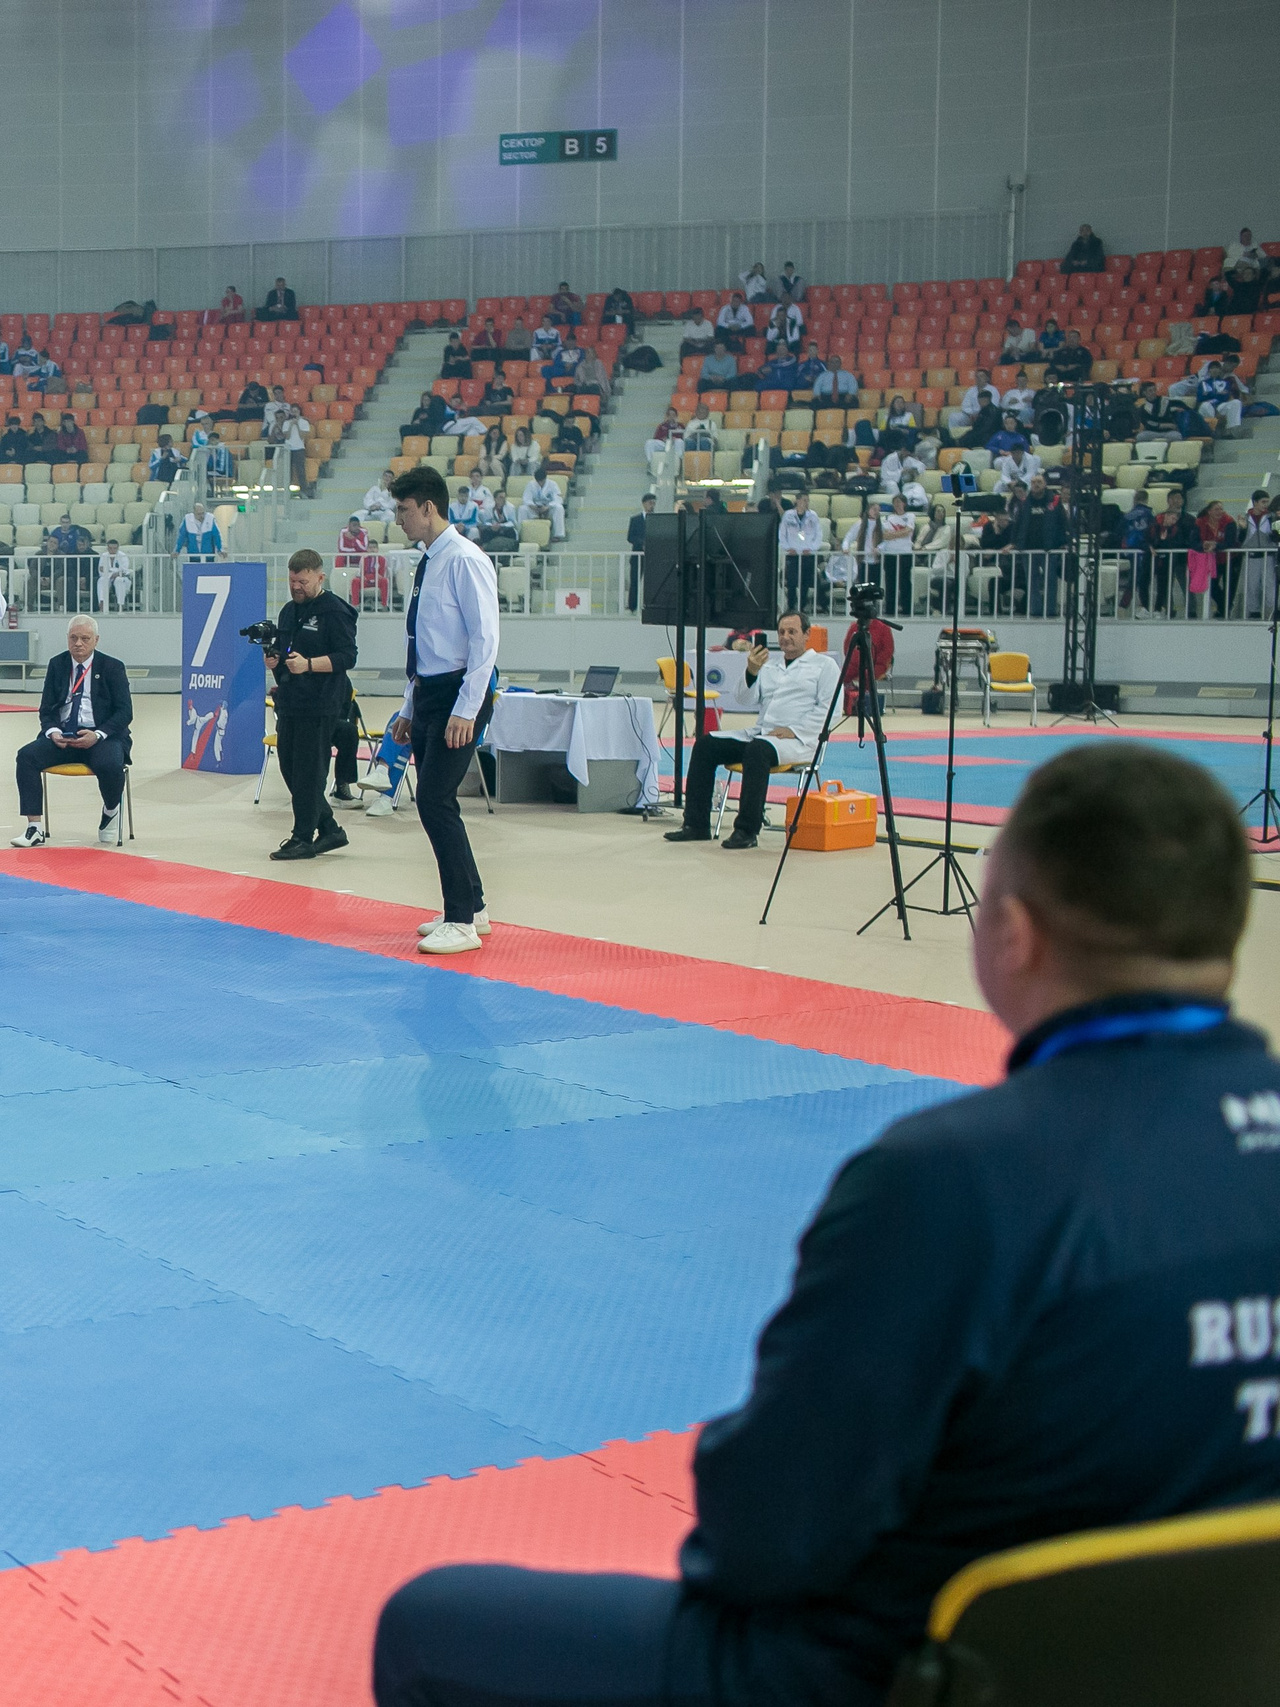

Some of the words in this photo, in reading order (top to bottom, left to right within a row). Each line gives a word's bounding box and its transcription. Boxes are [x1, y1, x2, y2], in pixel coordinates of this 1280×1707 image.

[501, 137, 545, 148] СЕКТОР
[595, 136, 608, 154] 5
[190, 575, 231, 667] 7
[189, 673, 225, 690] ДОЯНГ
[1189, 1296, 1280, 1366] RU
[1235, 1377, 1280, 1443] T
